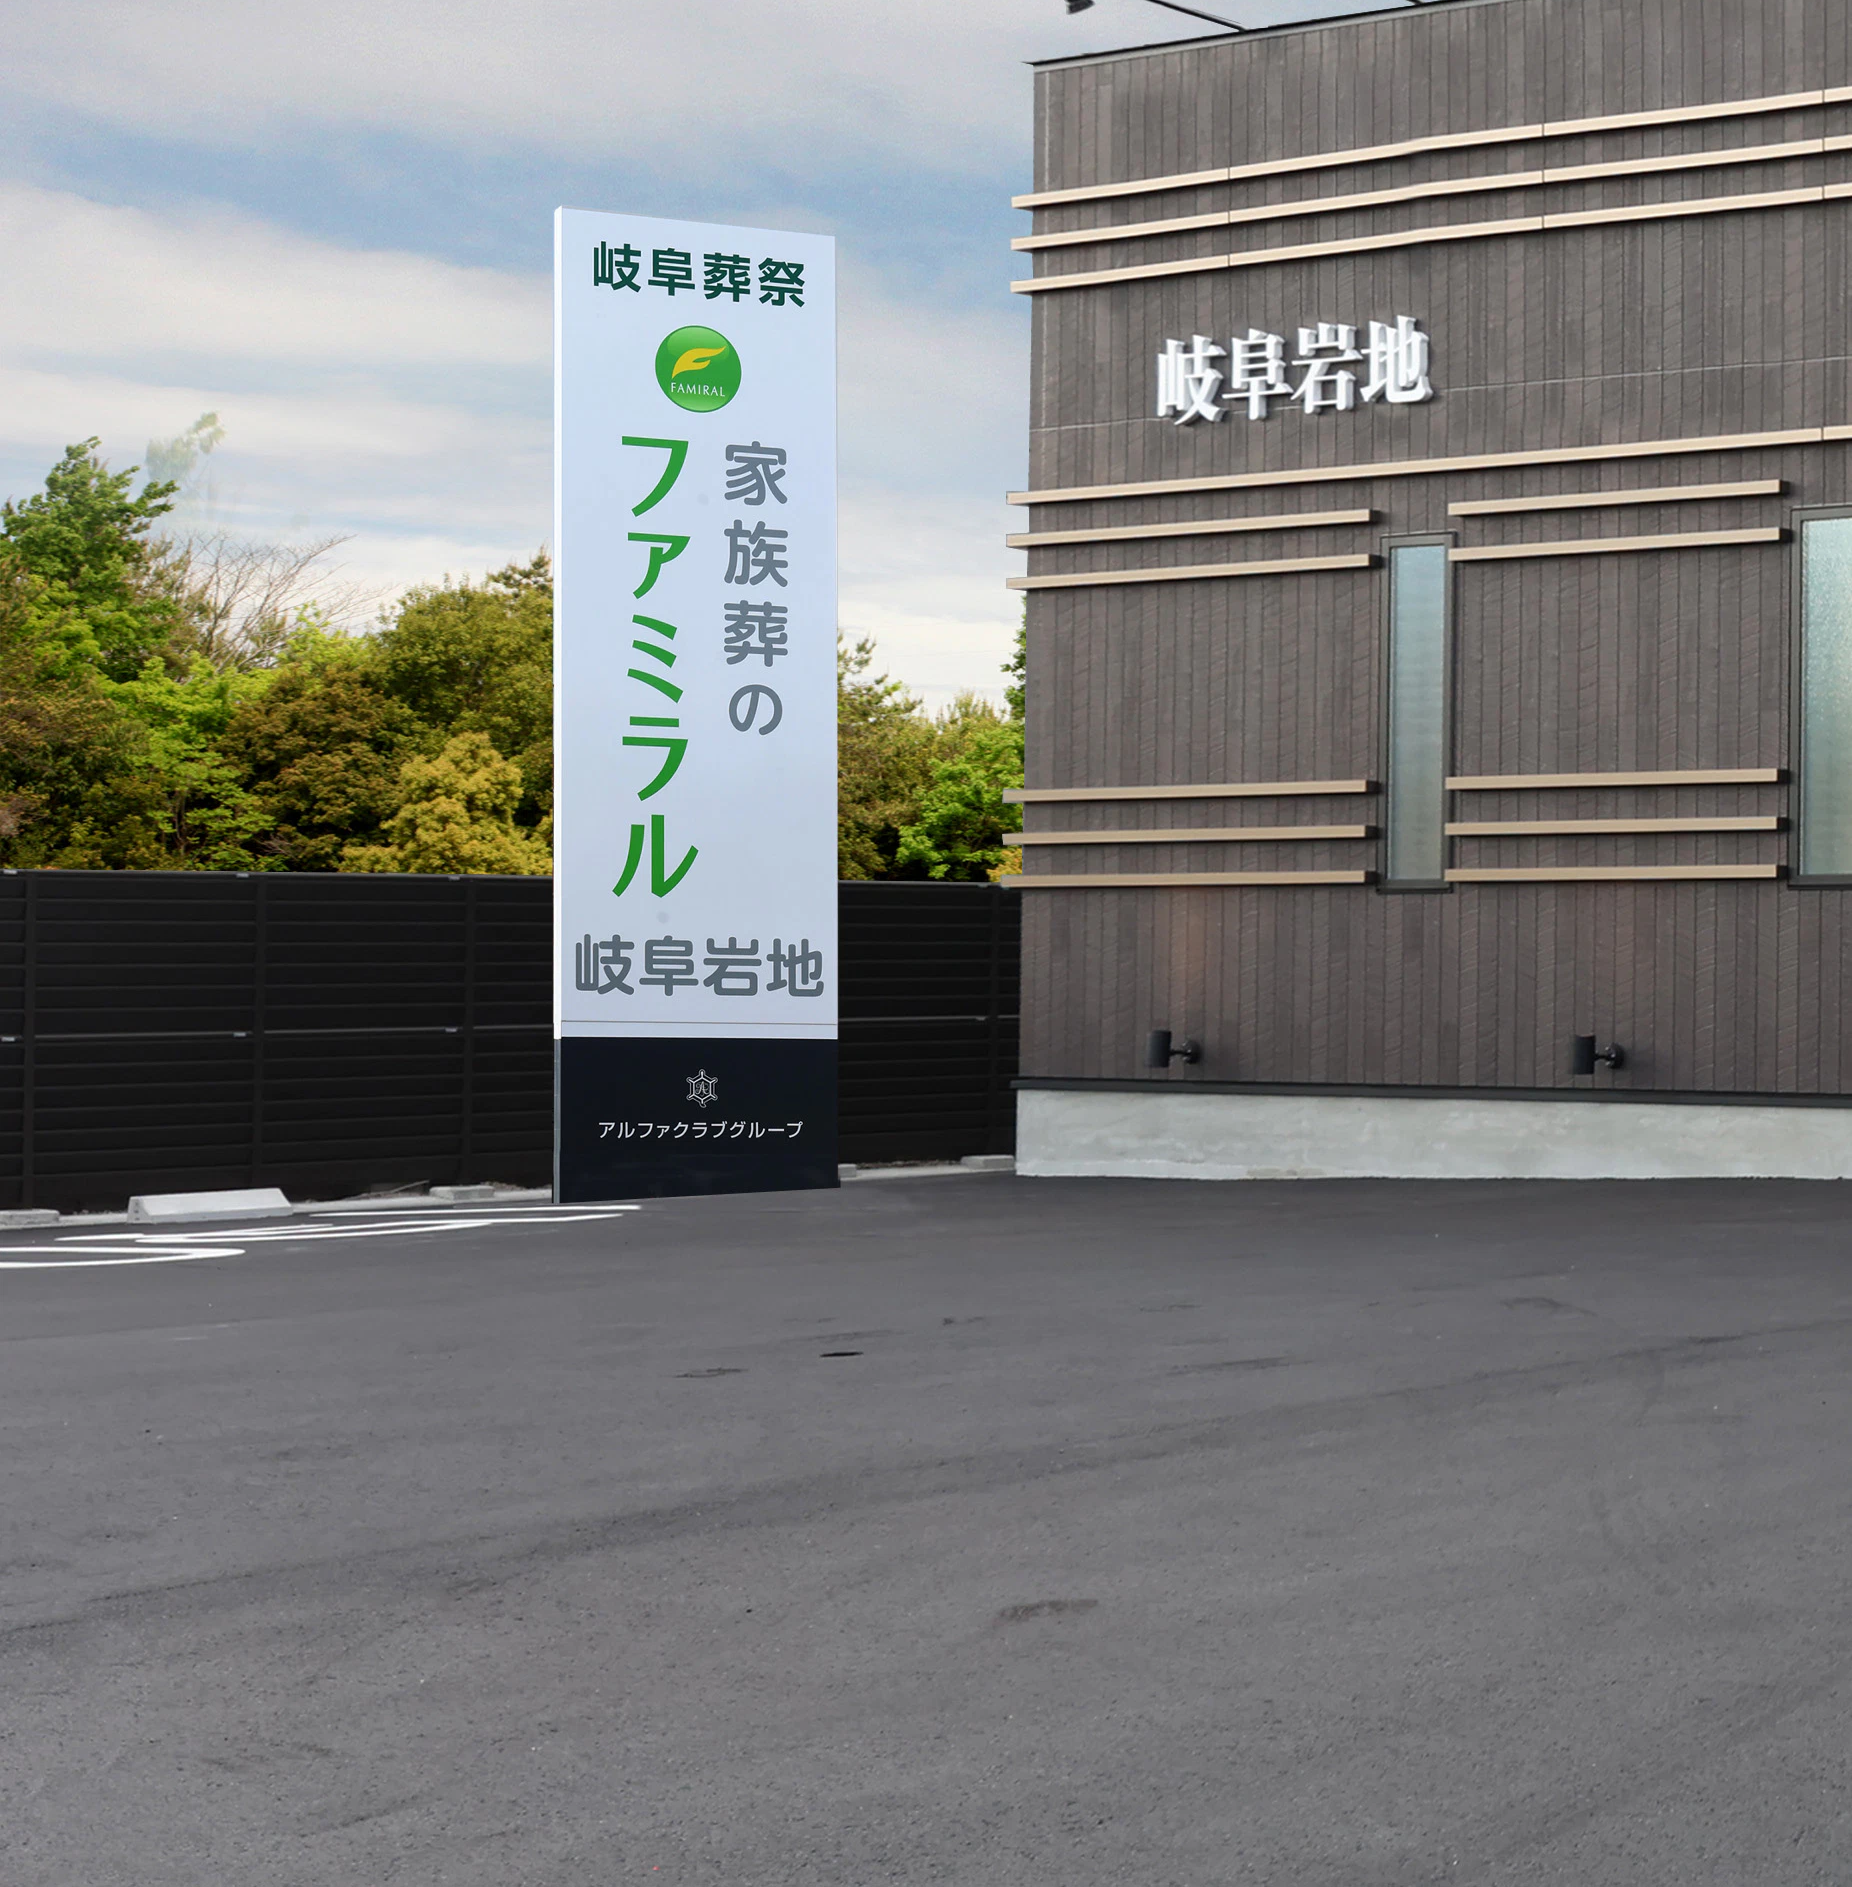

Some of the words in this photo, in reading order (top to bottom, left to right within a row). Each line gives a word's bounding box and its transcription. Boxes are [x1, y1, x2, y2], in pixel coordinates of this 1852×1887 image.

[593, 241, 805, 307] 岐阜葬祭
[671, 382, 725, 397] FAMIRAL
[1157, 315, 1433, 425] 岐阜岩地
[723, 441, 788, 736] 家族葬の
[612, 436, 699, 898] ファミラル
[576, 934, 824, 997] 岐阜岩地
[599, 1121, 804, 1139] アルファクラブグループ
